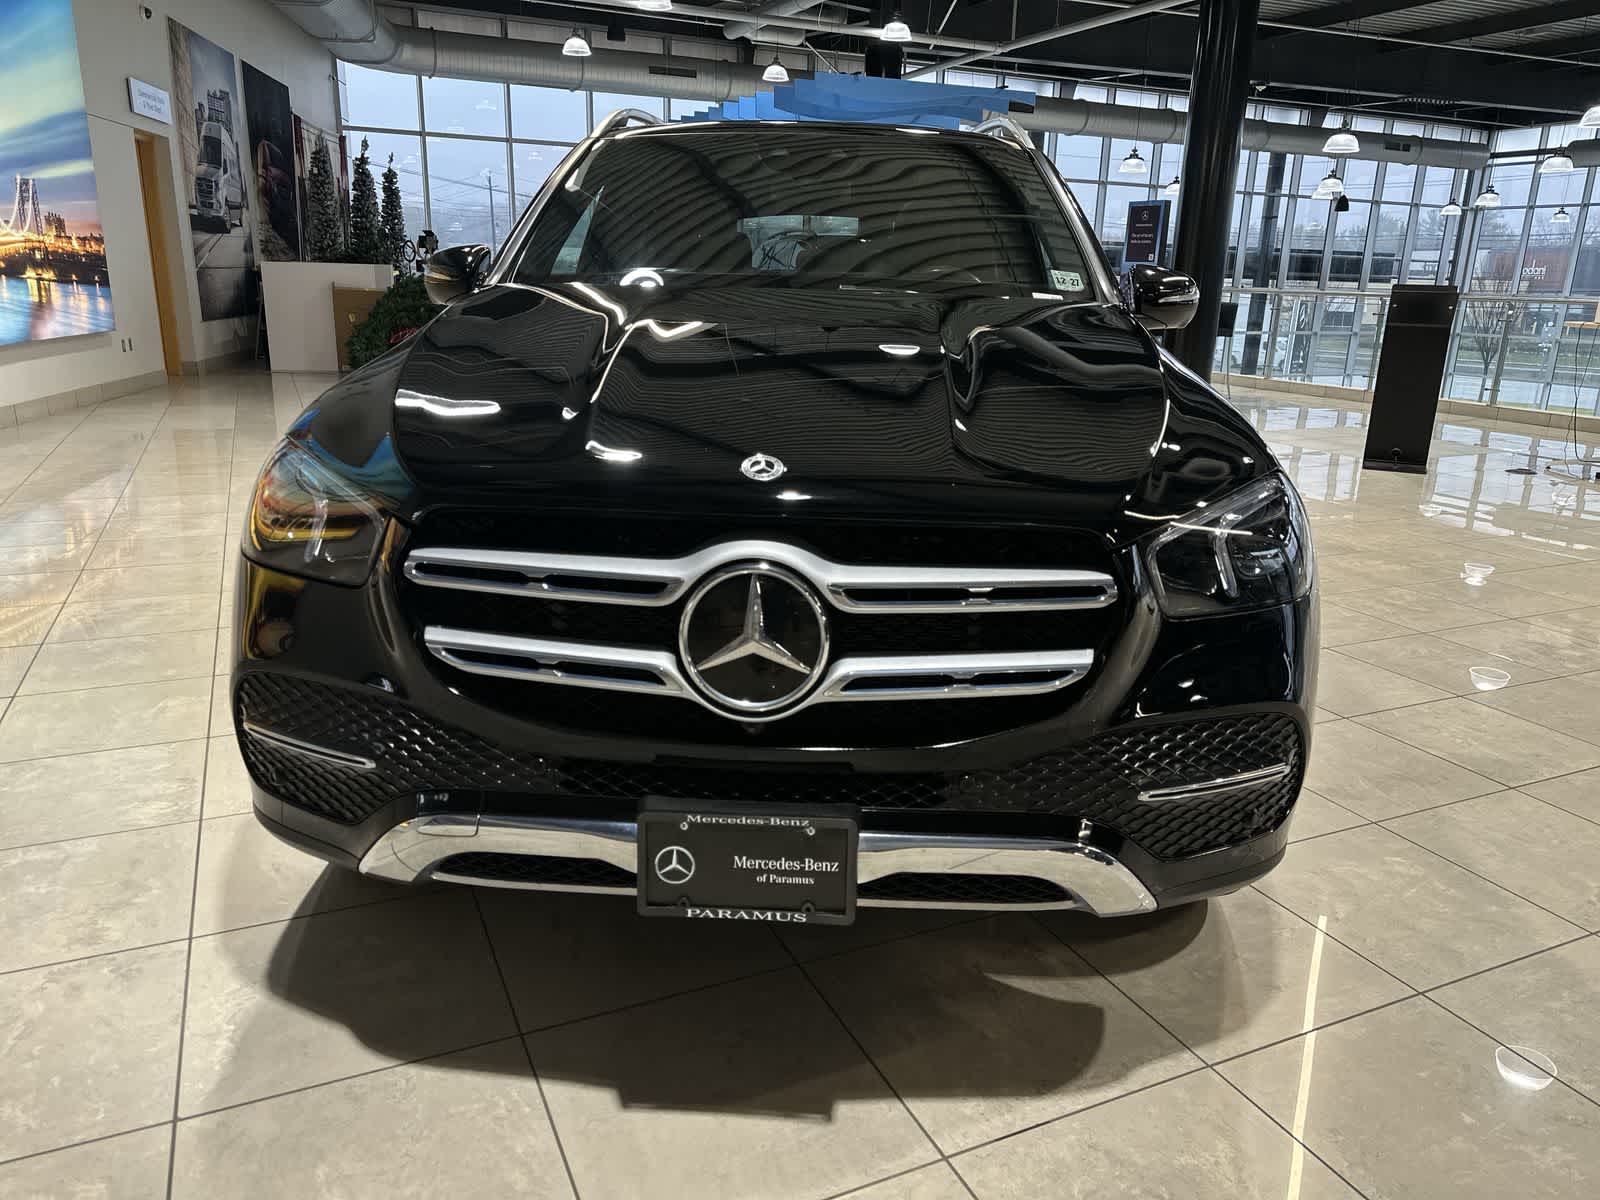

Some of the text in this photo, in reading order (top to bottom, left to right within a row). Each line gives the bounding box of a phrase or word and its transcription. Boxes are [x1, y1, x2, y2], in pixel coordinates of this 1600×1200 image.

[1069, 278, 1079, 287] 27
[686, 814, 810, 827] Mercedes-Benz
[733, 855, 839, 872] Mercedes-Benz
[756, 873, 815, 885] of Paramus
[686, 908, 808, 923] PARAMUS
